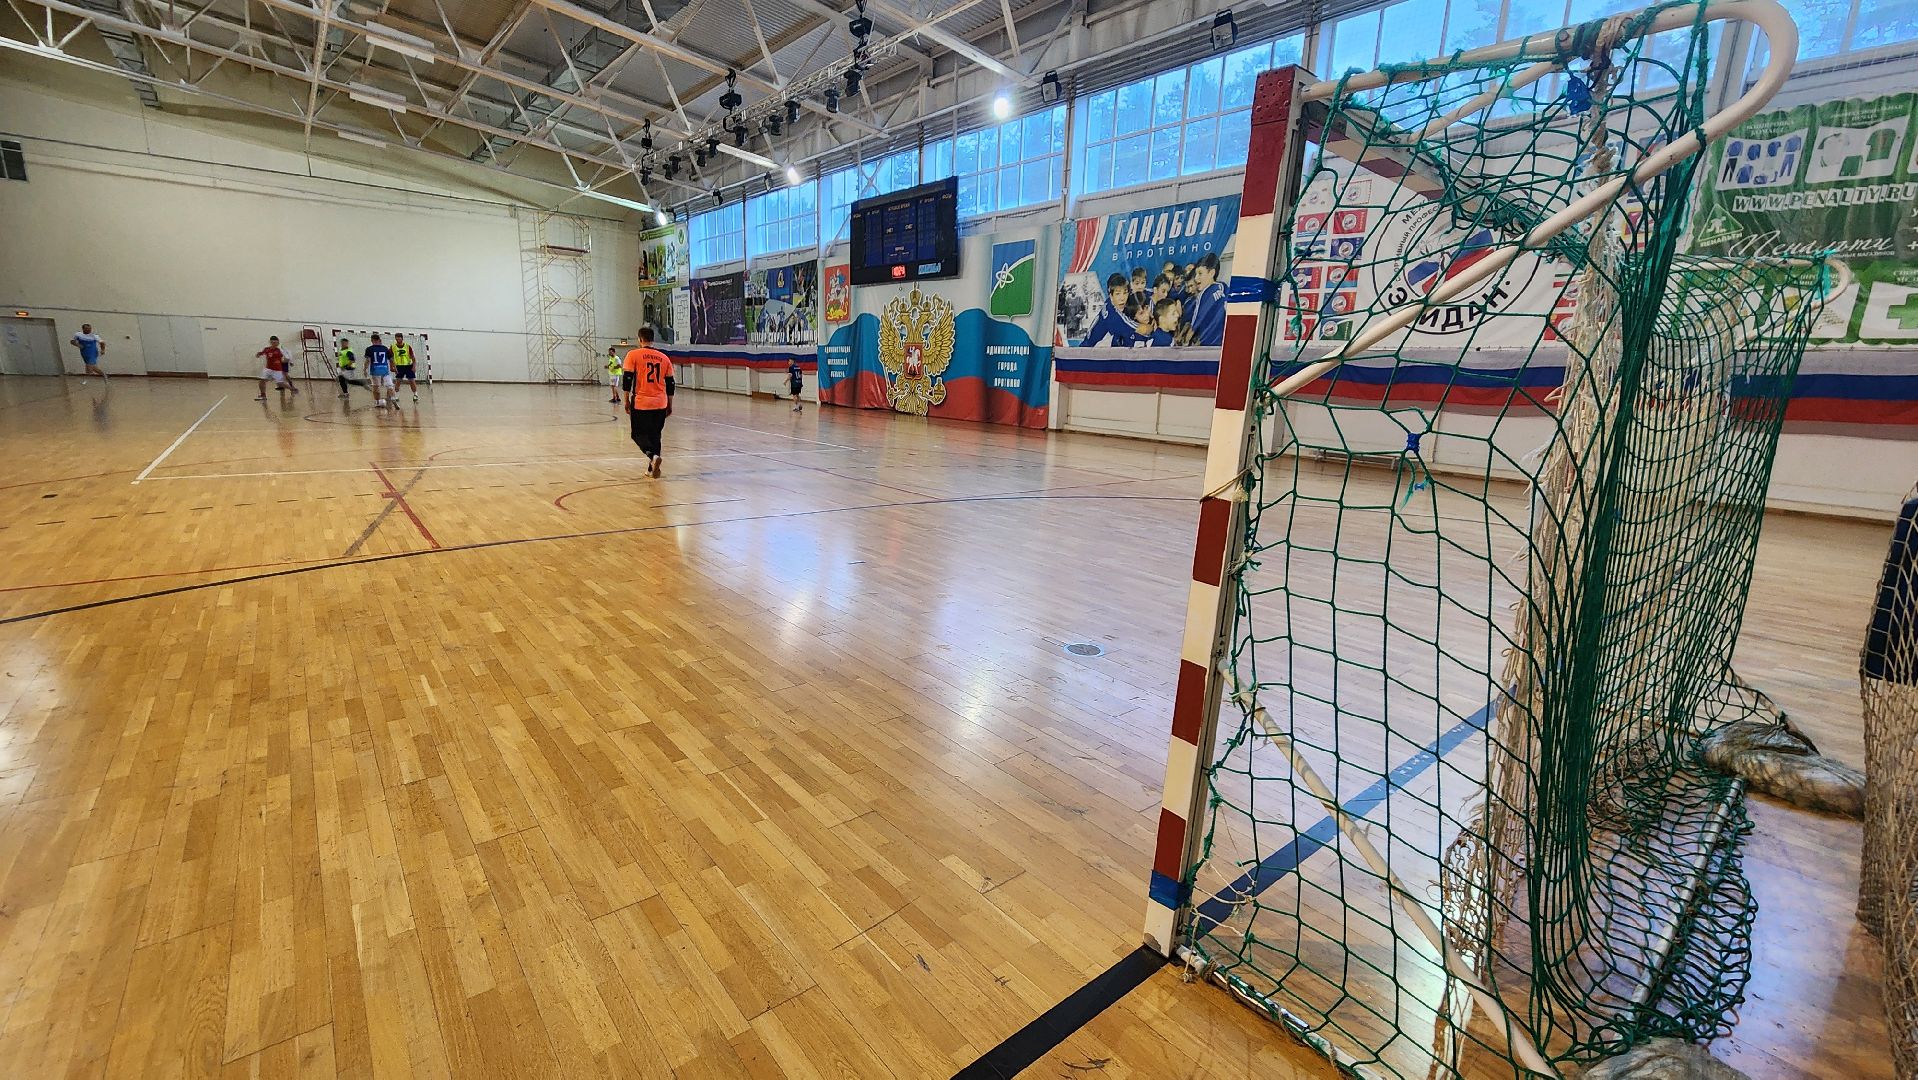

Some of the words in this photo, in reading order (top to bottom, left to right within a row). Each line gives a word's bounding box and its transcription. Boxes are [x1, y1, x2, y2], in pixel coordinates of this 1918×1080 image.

[1733, 184, 1916, 210] WWW.PENALTY.RU
[1113, 205, 1219, 246] ГАНДБОЛ
[1700, 232, 1742, 248] ПЕНАЛЬТИ
[1112, 252, 1118, 262] В
[1126, 242, 1212, 260] ПРОТВИНО
[1388, 287, 1508, 331] ЭИДАН
[373, 351, 386, 364] 17
[998, 361, 1018, 373] ГОРОДА
[646, 362, 660, 384] 21
